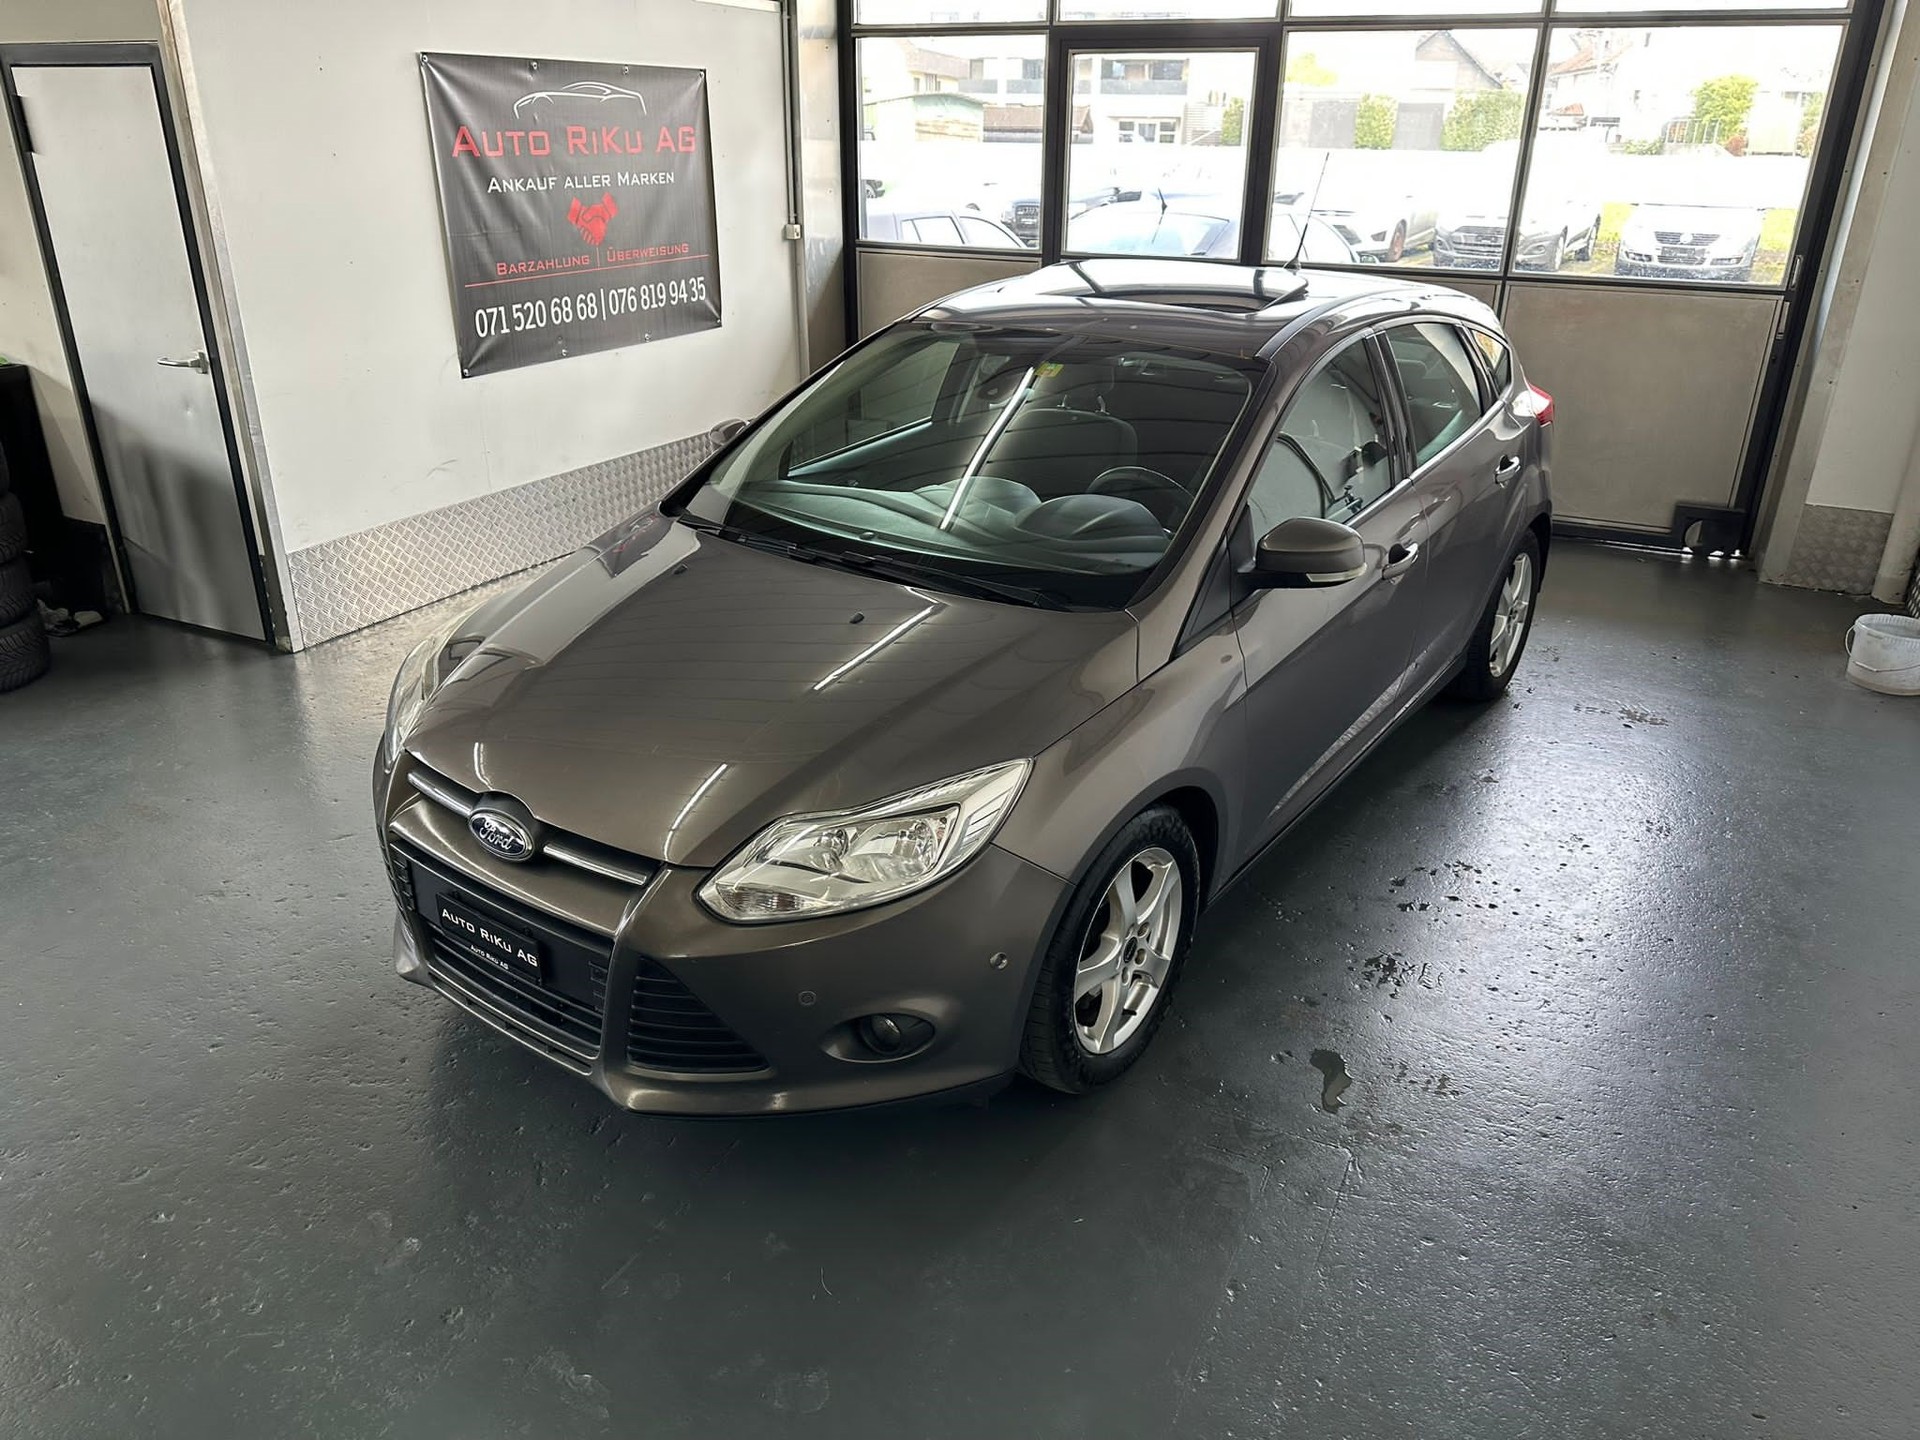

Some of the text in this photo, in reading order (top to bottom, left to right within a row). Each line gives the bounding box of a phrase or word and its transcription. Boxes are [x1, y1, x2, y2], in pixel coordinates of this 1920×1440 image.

[656, 125, 697, 154] AG
[487, 171, 675, 193] ANKAUF ALLER MARKEN
[496, 243, 689, 276] BARZAHLUNG ÜBERWEISUNG
[475, 306, 510, 338] 071
[512, 300, 547, 332] 520
[550, 296, 573, 325] 68
[576, 292, 598, 321] 68
[609, 286, 637, 315] 076
[640, 282, 666, 310] 819
[669, 279, 688, 305] 94
[690, 276, 706, 301] 35
[480, 819, 512, 850] Ford
[442, 908, 476, 933] AUTO
[517, 948, 538, 967] AG
